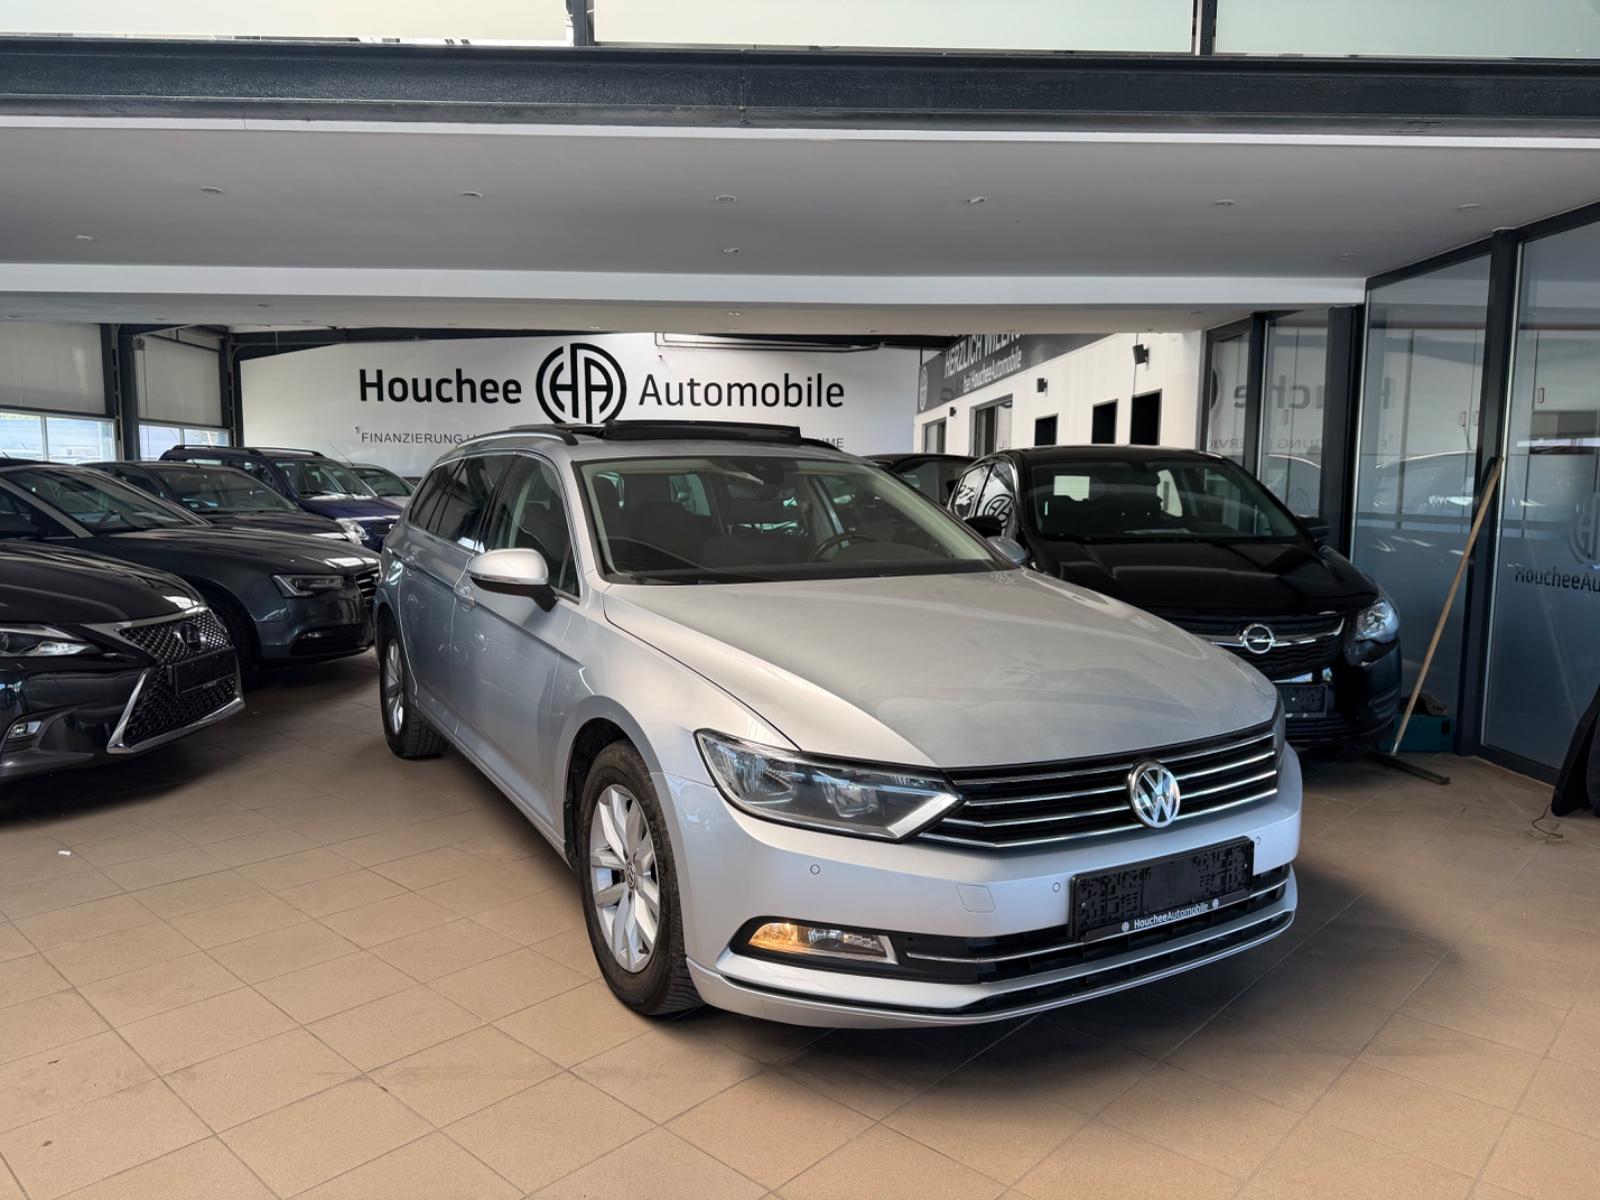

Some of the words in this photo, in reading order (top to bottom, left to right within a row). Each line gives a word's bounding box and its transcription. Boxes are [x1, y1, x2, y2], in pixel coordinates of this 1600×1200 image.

[944, 334, 983, 379] HERZLICH
[359, 368, 522, 404] Houchee
[639, 373, 844, 408] Automobile
[361, 432, 464, 445] FINANZIERUNG
[1133, 766, 1178, 826] VW
[1134, 902, 1209, 929] HoucheeAutomobile
